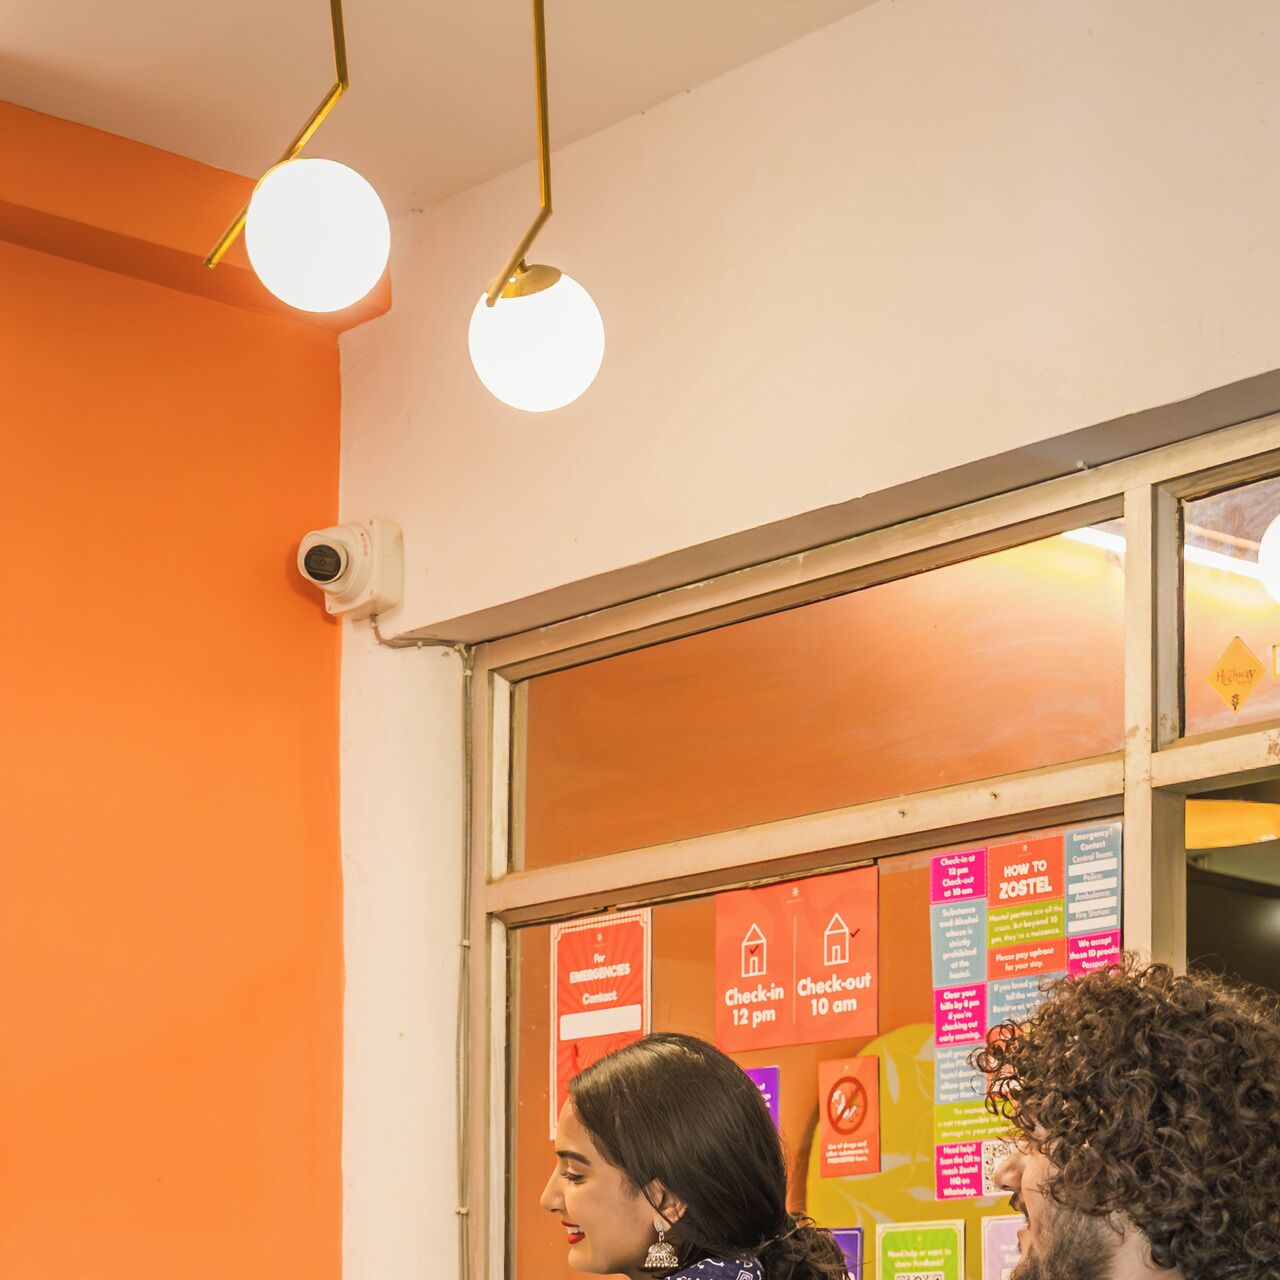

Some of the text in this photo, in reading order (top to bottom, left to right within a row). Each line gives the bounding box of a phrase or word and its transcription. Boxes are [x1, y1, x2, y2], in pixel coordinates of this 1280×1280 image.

[940, 855, 976, 866] Check-in at
[956, 867, 969, 876] pm
[1003, 859, 1048, 878] HOW TO
[942, 876, 974, 887] Check-out
[944, 889, 952, 898] at
[952, 887, 961, 896] 10
[999, 875, 1053, 900] ZOSTEL
[594, 953, 606, 963] For
[1015, 952, 1028, 962] pay
[570, 962, 630, 984] EMERGENCIES
[797, 972, 871, 997] Check-out
[582, 990, 618, 1005] Contact
[725, 982, 784, 1006] Check-in
[943, 990, 977, 1000] Clear your
[811, 997, 857, 1016] 10 am
[954, 1000, 963, 1010] by
[969, 1000, 980, 1009] pm
[733, 1007, 776, 1028] 12 pm
[967, 1020, 979, 1029] out
